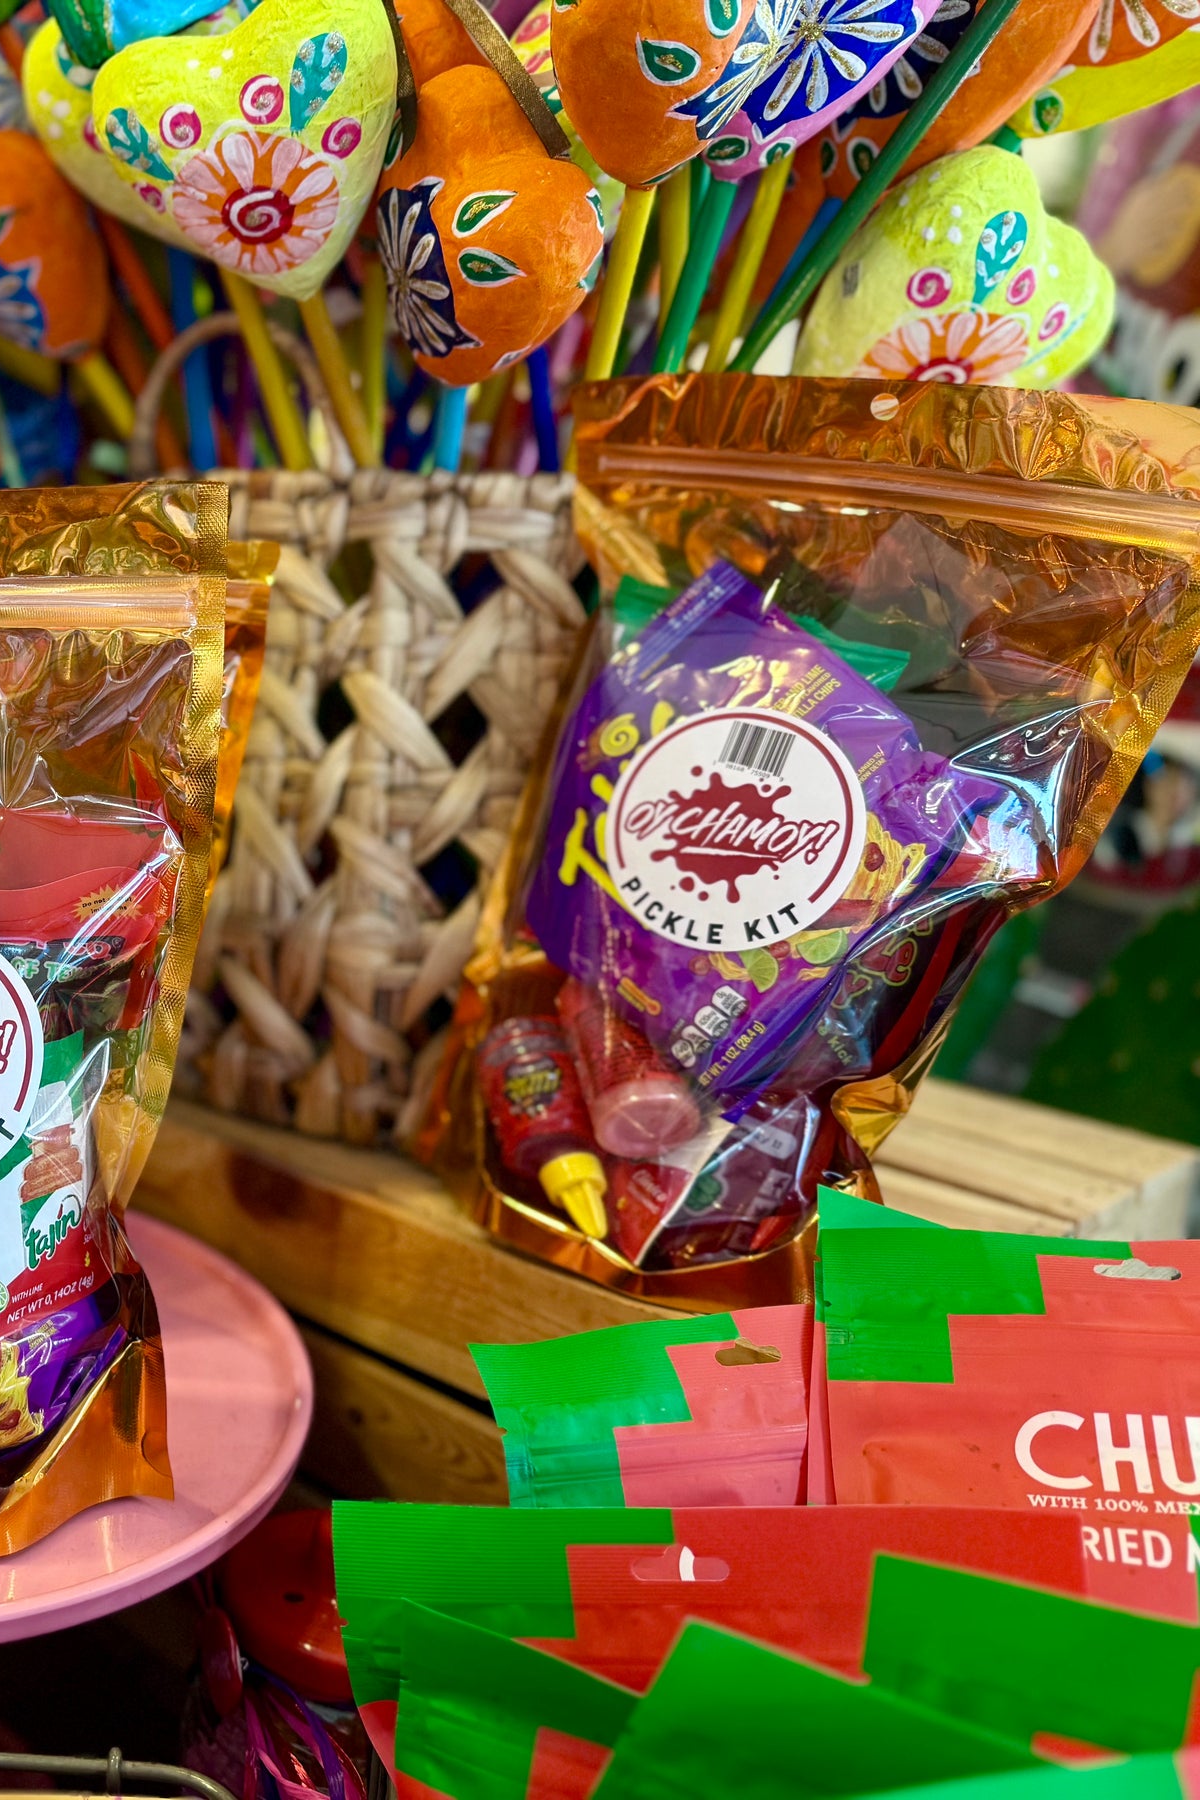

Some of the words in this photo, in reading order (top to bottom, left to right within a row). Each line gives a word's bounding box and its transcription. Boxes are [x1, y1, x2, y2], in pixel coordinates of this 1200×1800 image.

[803, 664, 826, 686] LIME
[813, 678, 842, 704] CHIPS
[625, 800, 679, 840] OY
[670, 801, 840, 864] CHAMOY!
[621, 877, 723, 944] PICKLE
[744, 903, 799, 942] KIT
[11, 1289, 29, 1304] WITH
[28, 1283, 44, 1297] LIME
[7, 1306, 26, 1324] NET
[27, 1298, 45, 1315] WT
[1014, 1410, 1200, 1497] CHU
[1026, 1493, 1088, 1510] WITH
[1094, 1497, 1149, 1514] 100%
